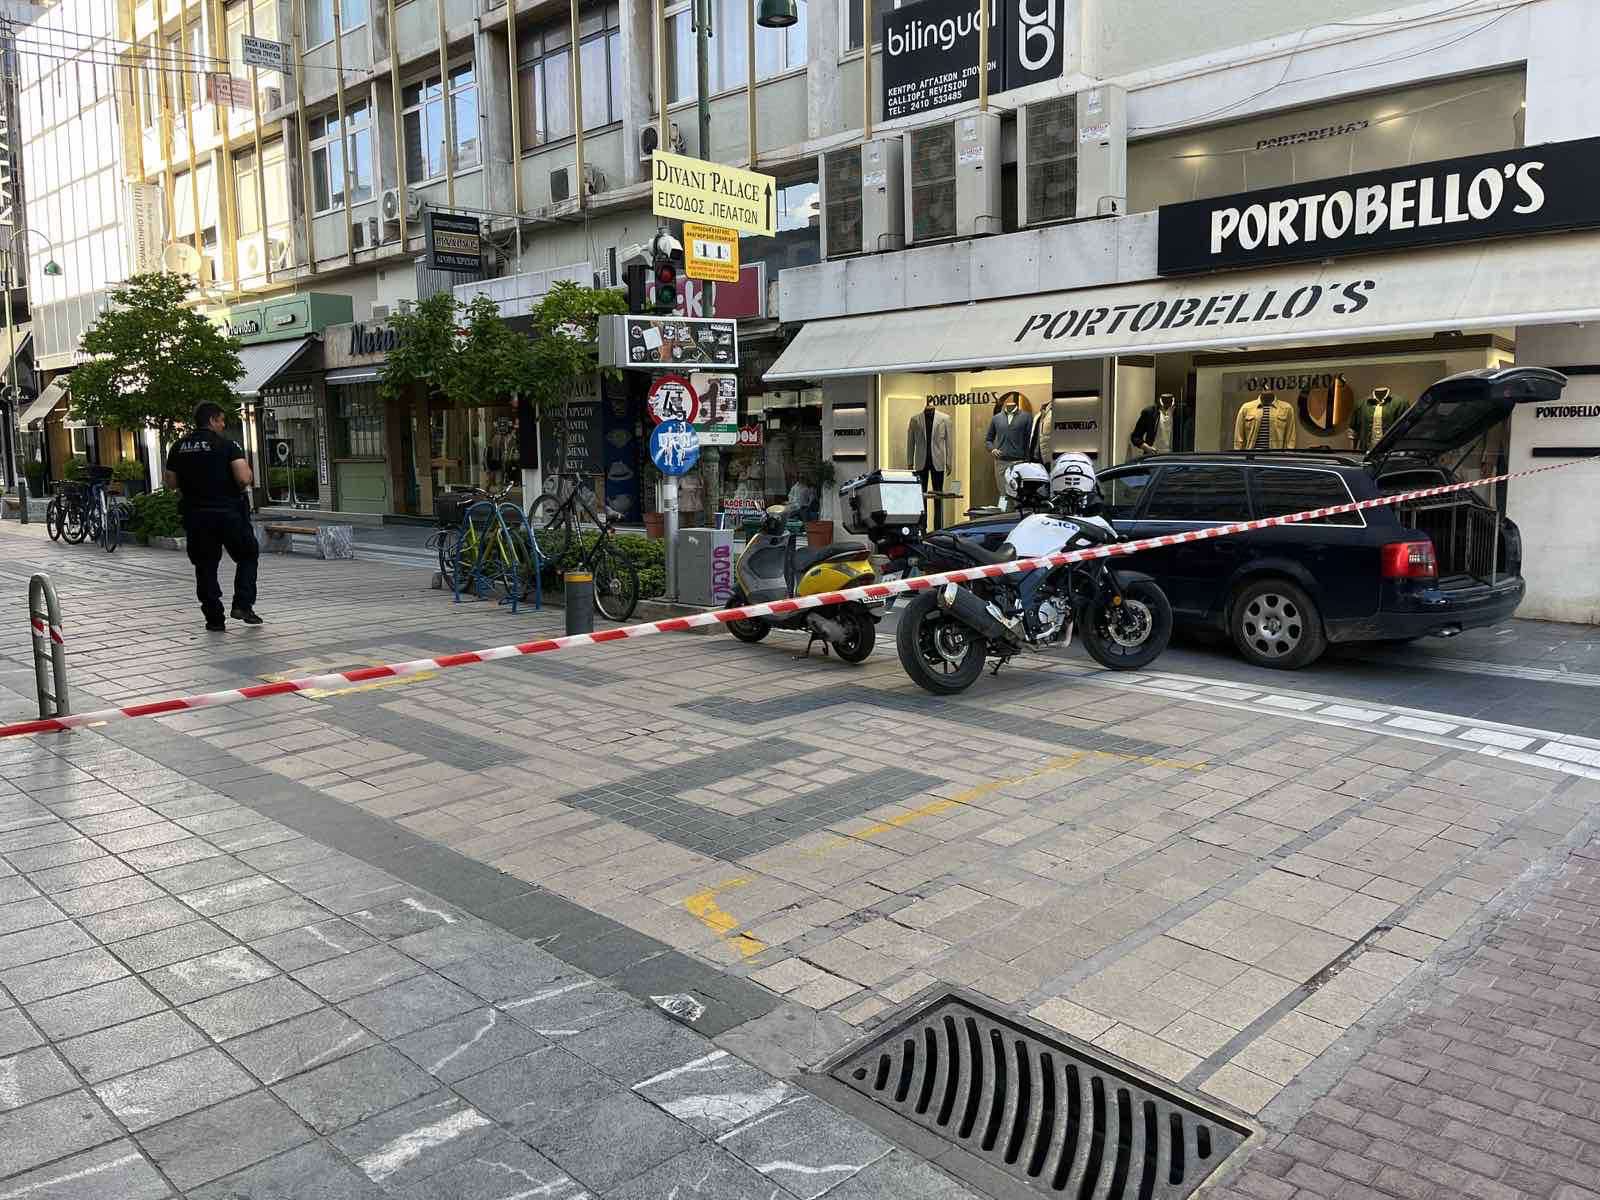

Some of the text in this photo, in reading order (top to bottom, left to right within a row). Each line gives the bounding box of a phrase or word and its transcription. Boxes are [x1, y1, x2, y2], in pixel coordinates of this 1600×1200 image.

[888, 60, 997, 96] ΚΕΝΤΡΟ ΑΓΓΛΙΚΩΝ ΣΠΟΥΩΝ
[888, 92, 925, 107] CALLIOPI
[888, 106, 906, 116] TEL:
[911, 100, 930, 111] 2410
[656, 160, 760, 202] DIVANI PALACE
[658, 191, 758, 225] ΕΙΣΟΔΟΣ ΠΕΛΑΤΩΝ
[1210, 161, 1546, 255] PORTOBELLO'S
[1014, 279, 1376, 343] PORTOBELLO'S
